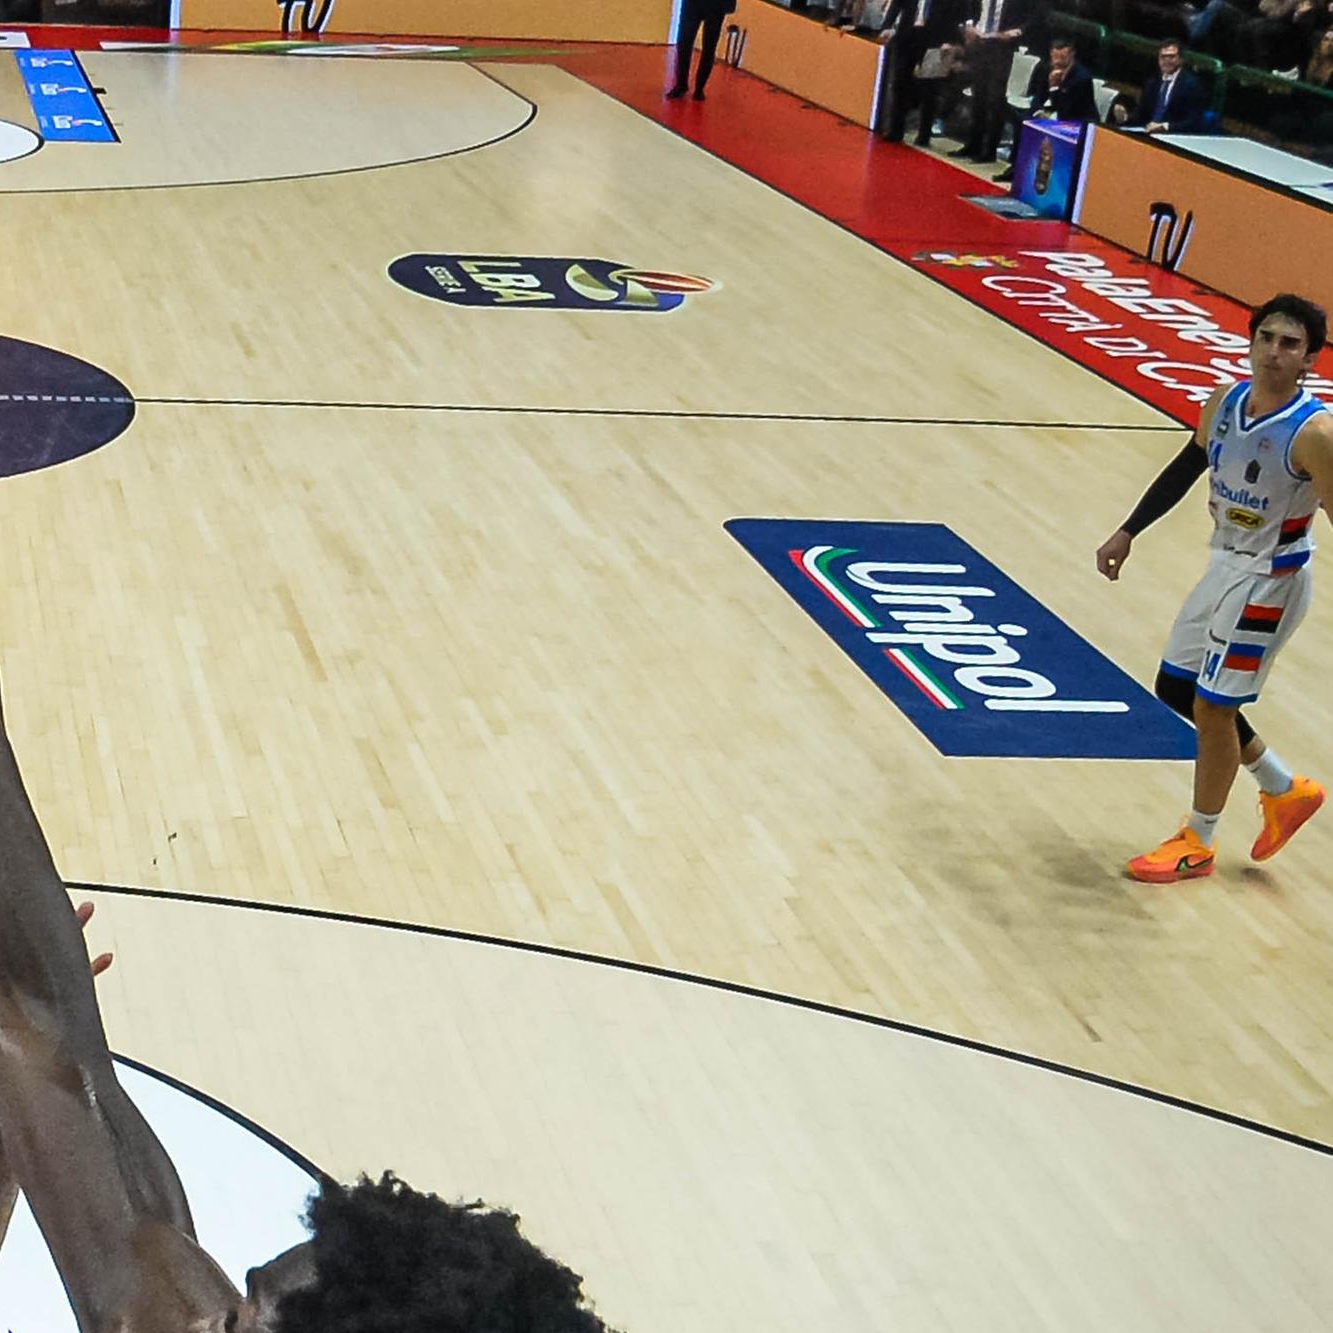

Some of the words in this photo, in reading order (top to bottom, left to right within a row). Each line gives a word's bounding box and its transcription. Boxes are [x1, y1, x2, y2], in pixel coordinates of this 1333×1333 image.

[456, 260, 557, 303] LBA
[1084, 336, 1168, 359] DI
[845, 560, 1131, 713] Unipol
